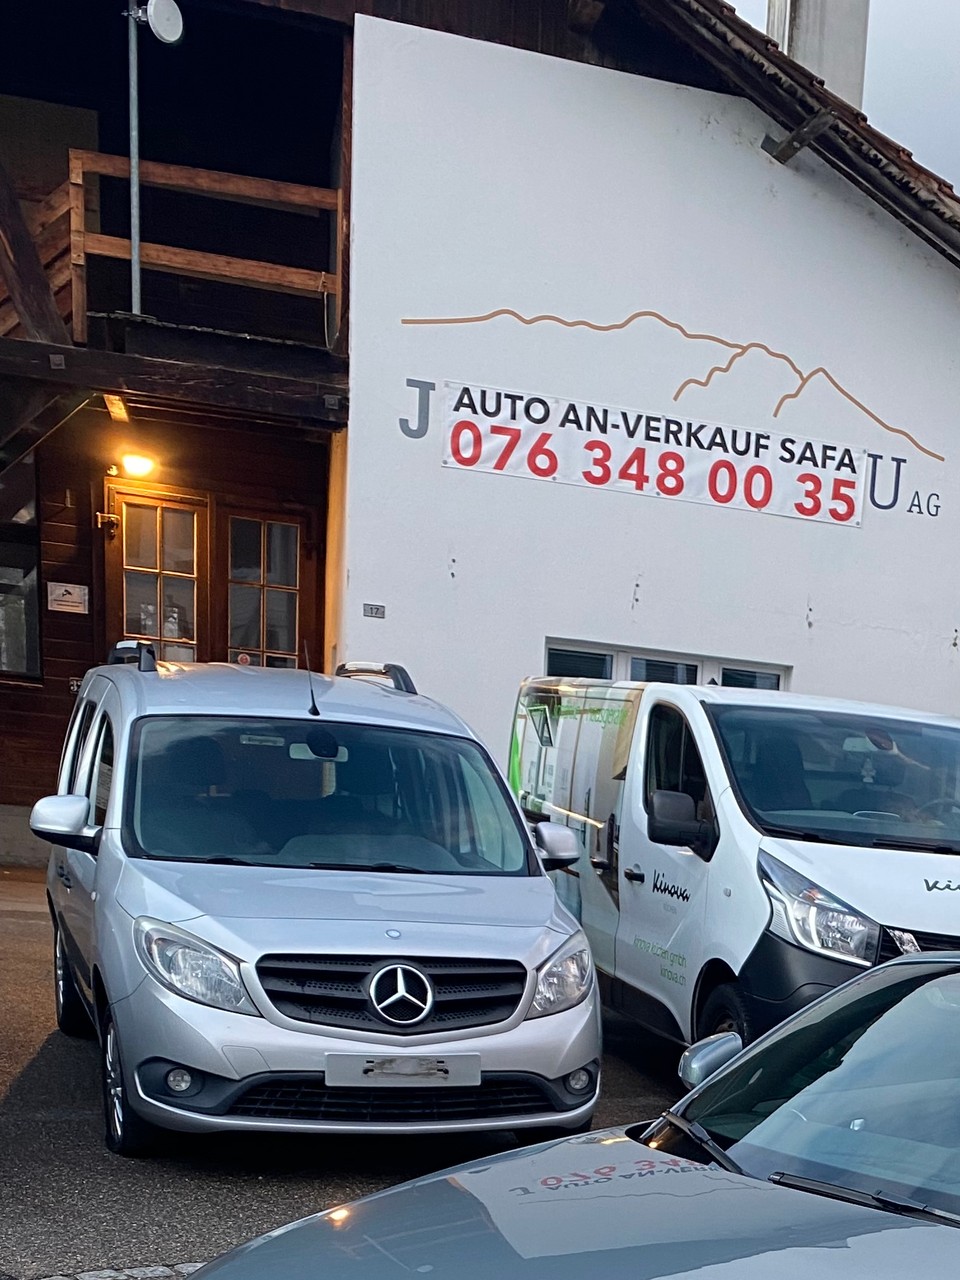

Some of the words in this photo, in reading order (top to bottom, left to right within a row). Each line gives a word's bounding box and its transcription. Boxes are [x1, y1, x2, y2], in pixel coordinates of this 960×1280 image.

[399, 378, 436, 439] J
[867, 452, 908, 510] U
[906, 490, 942, 517] AG
[449, 420, 559, 478] 076
[582, 439, 686, 496] 348
[707, 459, 773, 508] 00
[794, 473, 858, 521] 35
[452, 386, 550, 425] AUTO
[559, 404, 770, 458] AN-VERKAUF
[778, 438, 858, 474] SAFA
[370, 606, 380, 616] 17
[652, 869, 691, 902] Kinova
